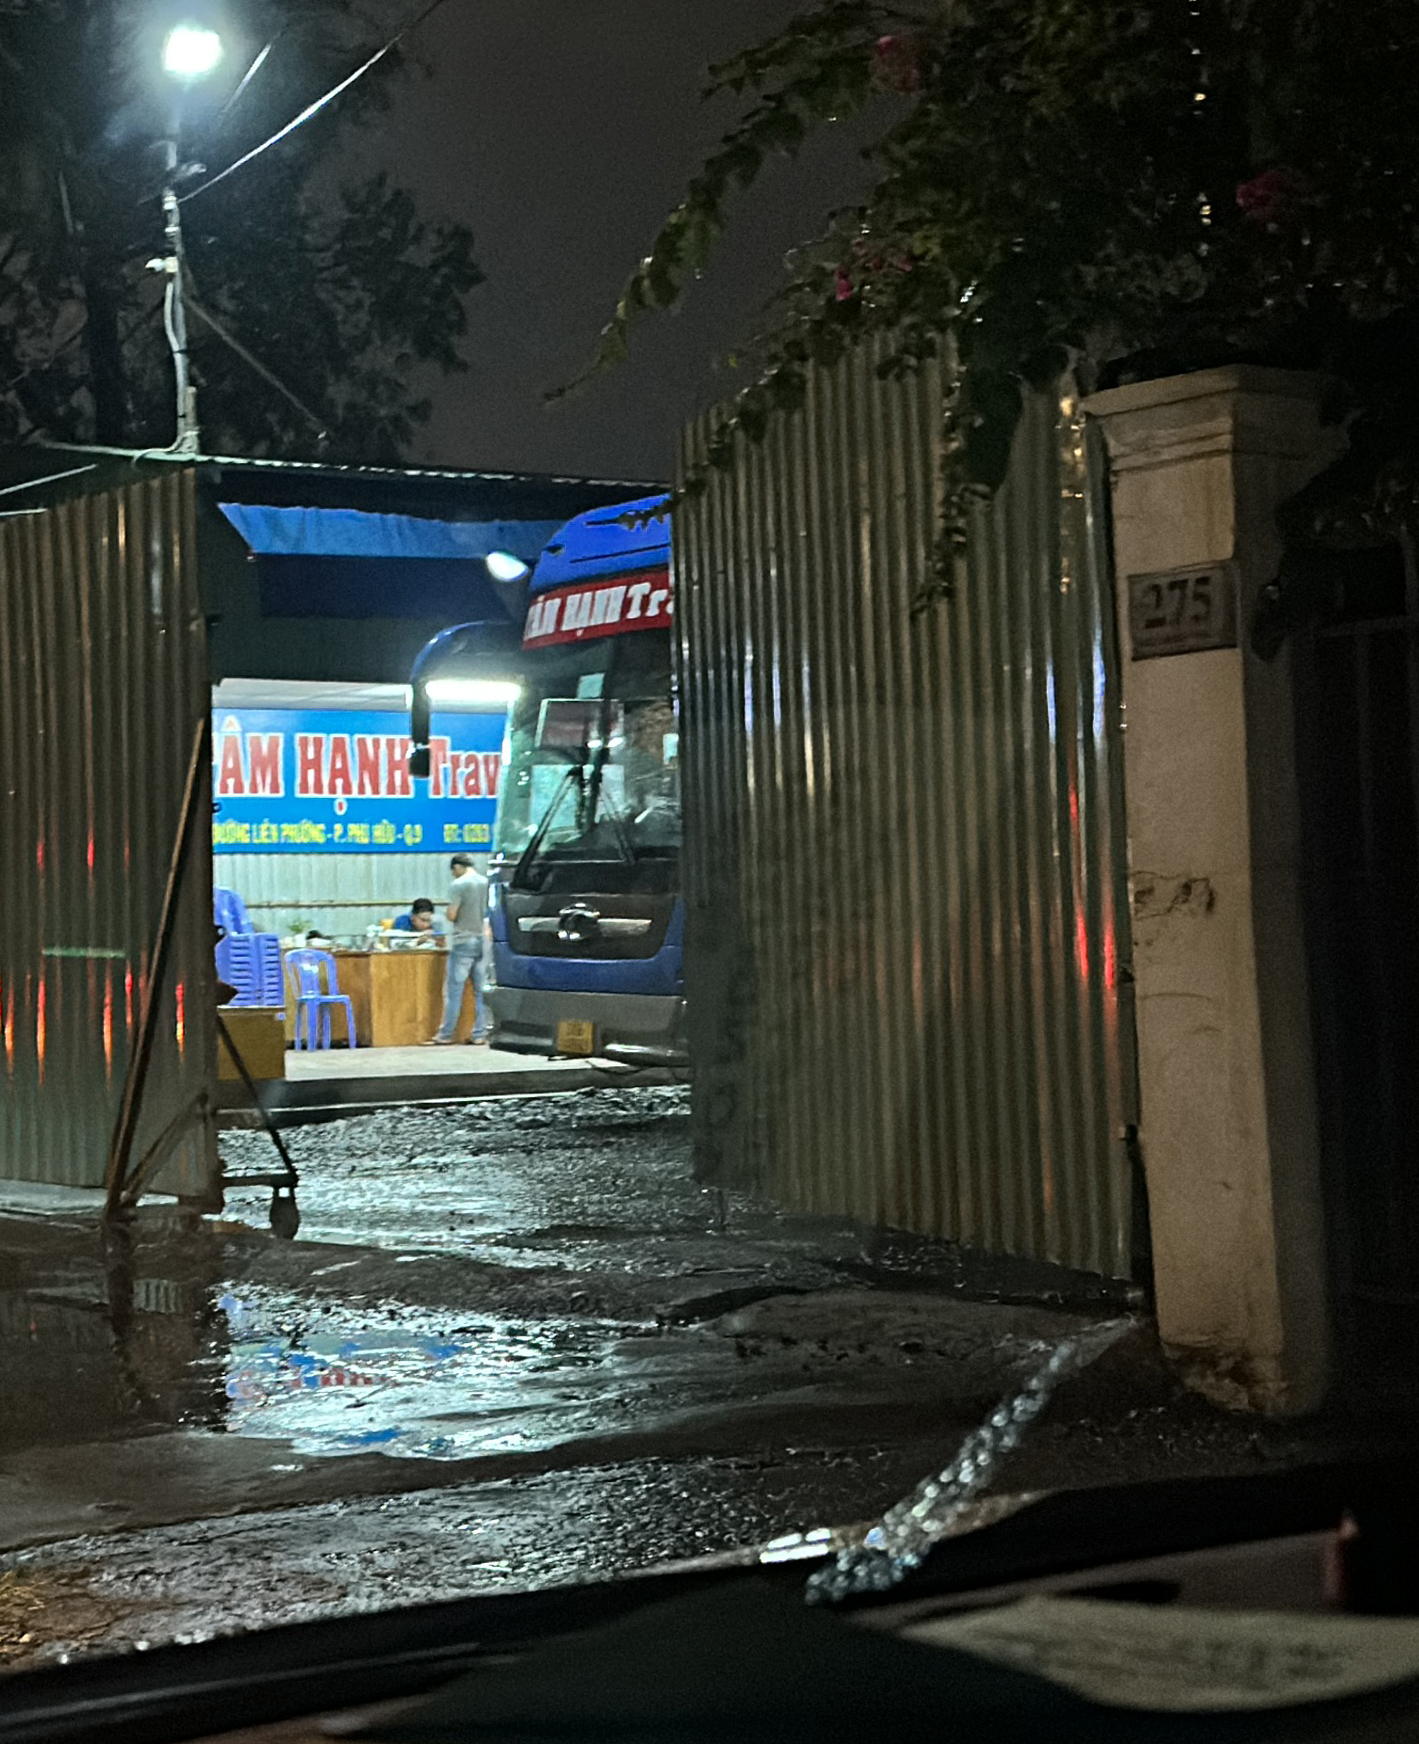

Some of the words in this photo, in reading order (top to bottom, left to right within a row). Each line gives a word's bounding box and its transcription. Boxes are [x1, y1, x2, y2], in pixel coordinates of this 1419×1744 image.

[1142, 576, 1212, 629] 275
[213, 714, 284, 798] ÂM
[295, 733, 415, 815] HẠNH
